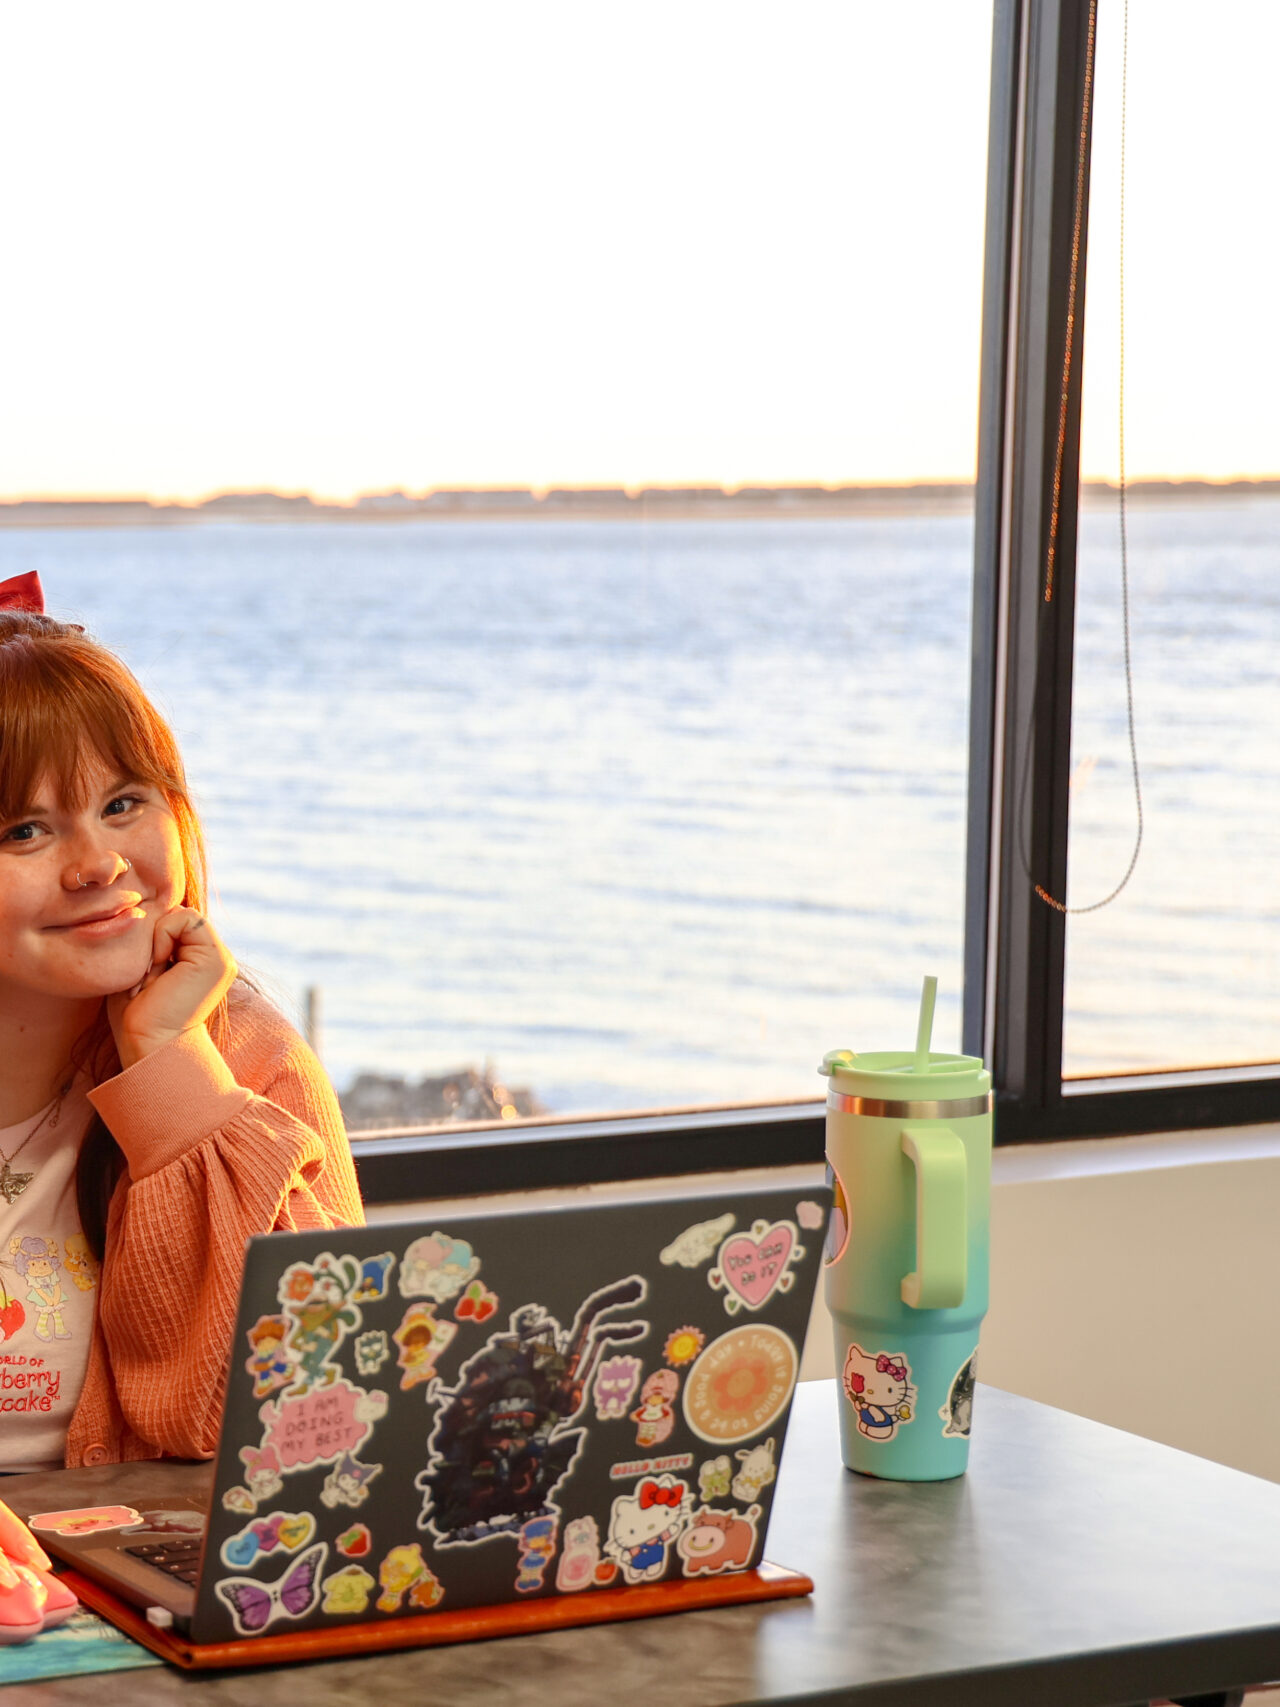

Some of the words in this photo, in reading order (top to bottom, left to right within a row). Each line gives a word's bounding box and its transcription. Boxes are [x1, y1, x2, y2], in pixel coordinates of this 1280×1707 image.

[29, 1358, 45, 1367] OF
[297, 1404, 304, 1416] I
[315, 1397, 338, 1412] AM
[285, 1411, 344, 1436] DOING
[281, 1440, 304, 1453] MY
[315, 1426, 352, 1447] BEST
[612, 1461, 650, 1476] HELLO
